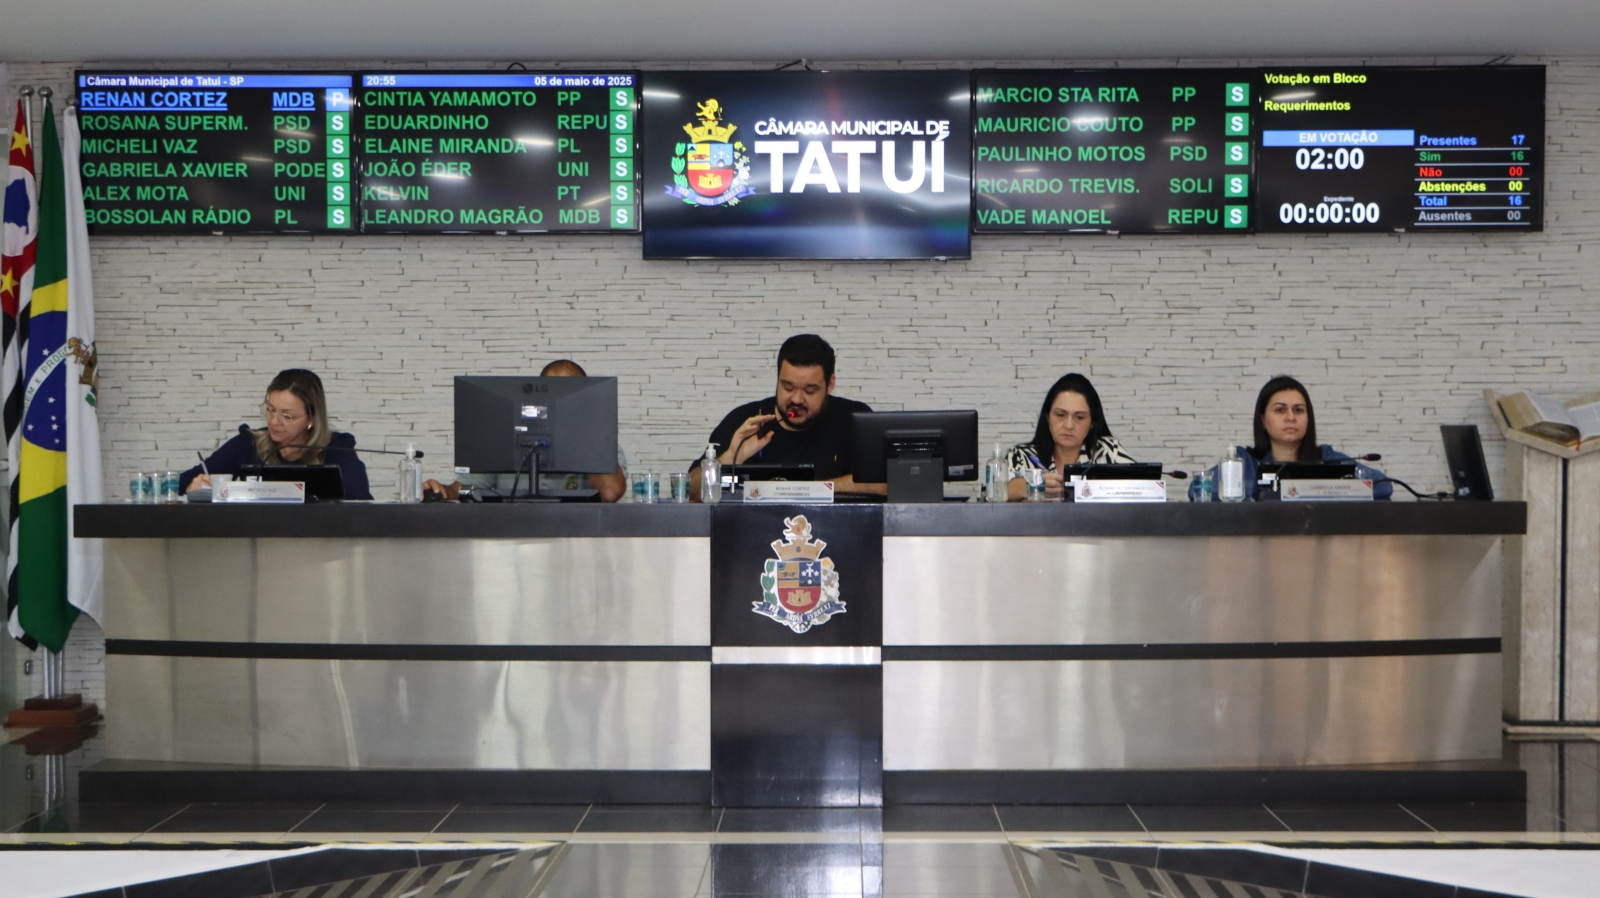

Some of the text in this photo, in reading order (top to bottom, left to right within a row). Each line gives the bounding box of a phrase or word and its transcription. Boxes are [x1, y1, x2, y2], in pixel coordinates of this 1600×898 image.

[87, 76, 126, 86] Câmara
[129, 76, 178, 87] Municipal
[181, 76, 193, 86] de
[229, 77, 244, 86] SP
[367, 76, 395, 85] 20:55
[535, 76, 632, 85] 05 de maio de 2025
[1265, 73, 1366, 85] Votação em Bloco
[81, 92, 344, 107] RENAN CORTEZ MDB P
[365, 91, 628, 106] CINTIA YAMAMOTO PP S
[978, 87, 1244, 103] MARCIO STA RITA PP S
[1265, 100, 1351, 113] Requerimentos
[81, 116, 344, 130] ROSANA SUPERM. PSD S
[365, 115, 628, 130] EDUARDINHO REPU S
[755, 118, 950, 135] CÂMARA MUNICIPAL DE
[978, 117, 1243, 132] MAURICIO COUTO PP S
[1299, 131, 1378, 144] EM VOTAÇÃO
[1419, 135, 1524, 146] Presentes 17
[82, 139, 344, 154] MICHELI VAZ PSD S
[365, 138, 628, 153] ELAINE MIRANDA PL S
[978, 146, 1243, 162] PAULINHO MOTOS PSD S
[1295, 148, 1364, 170] 02:00
[1419, 151, 1524, 161] Sim 16
[82, 163, 344, 177] GABRIELA XAVIER PODE S
[364, 159, 628, 177] JOÃO ÉDER UNI S
[755, 134, 950, 193] TATUÍ
[1419, 167, 1523, 177] Não 00
[83, 186, 344, 201] ALEX MOTA UNI S
[364, 186, 628, 201] KELVIN PT S
[977, 178, 1243, 194] RICARDO TREVIS. SOLI S
[1419, 181, 1522, 193] Abstenções 00
[1419, 196, 1522, 206] Total 16
[85, 206, 345, 225] BOSSOLAN RÁDIO PL S
[364, 206, 628, 224] LEANDRO MAGRÃO MDB S
[977, 209, 1242, 225] VADE MANOEL REPU S
[1280, 203, 1380, 223] 00:00:00
[1418, 210, 1521, 221] Ausentes 00
[769, 604, 780, 613] PER
